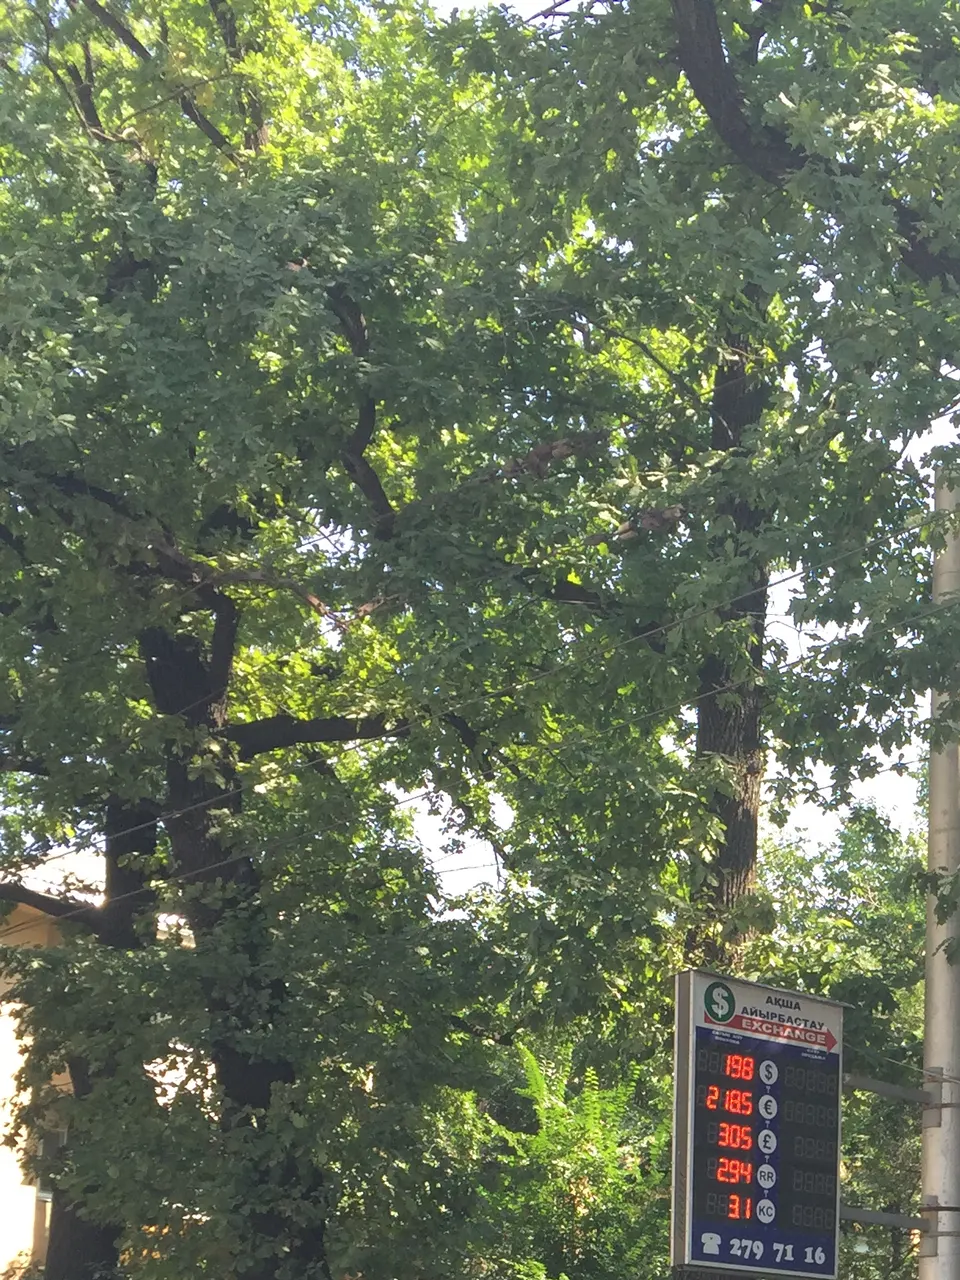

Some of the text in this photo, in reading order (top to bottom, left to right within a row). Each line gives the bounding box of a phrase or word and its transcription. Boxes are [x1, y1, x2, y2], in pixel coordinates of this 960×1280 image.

[740, 1006, 825, 1031] АЙЫРБАСТАУ
[741, 1018, 826, 1044] EXCHANGE
[725, 1054, 755, 1081] 198
[759, 1170, 774, 1183] RR
[729, 1238, 826, 1265] 279 71 16
